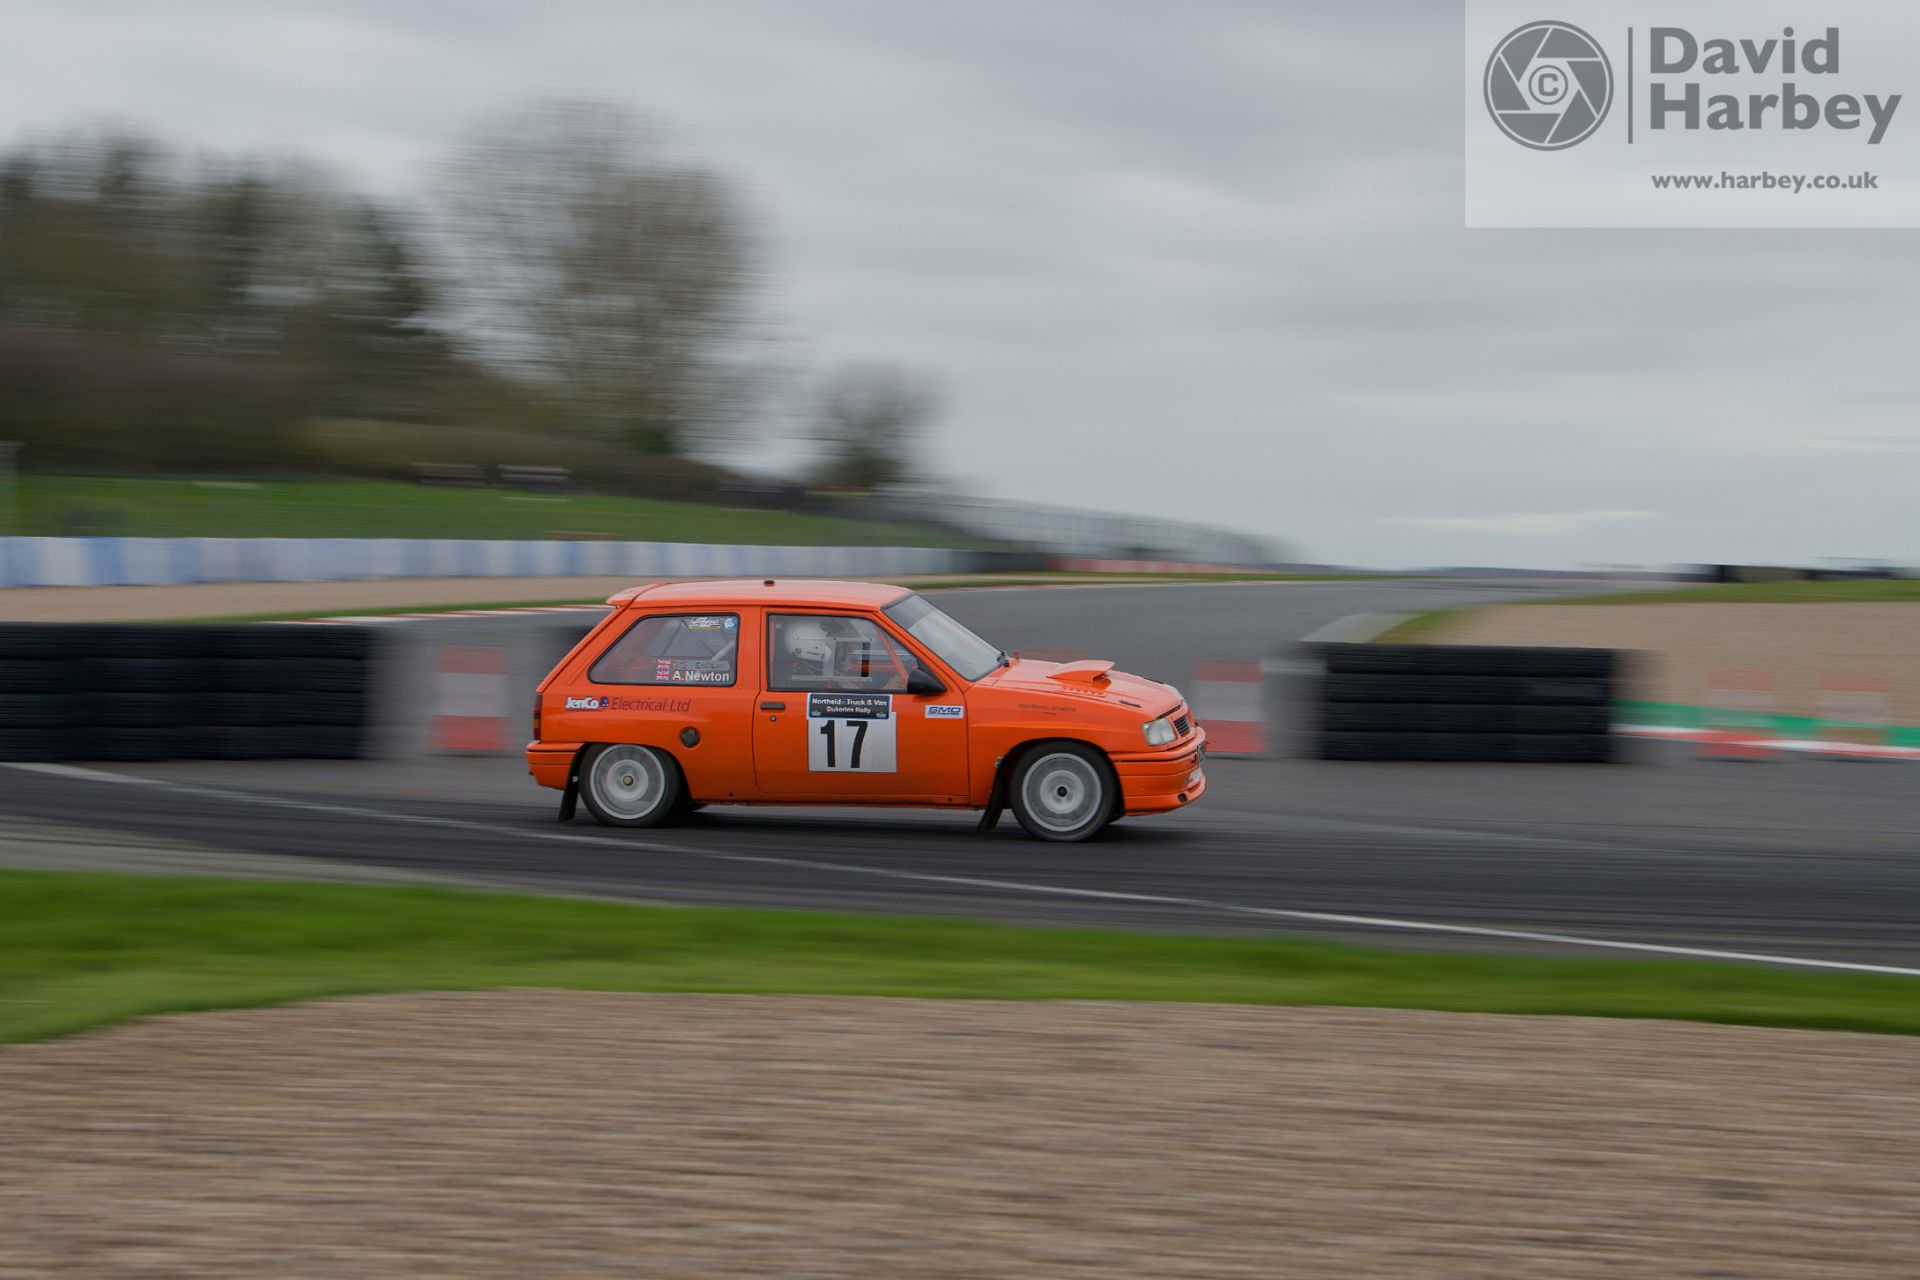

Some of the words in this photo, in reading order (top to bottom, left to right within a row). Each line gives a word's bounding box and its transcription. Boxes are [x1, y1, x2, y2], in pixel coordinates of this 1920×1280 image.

[672, 671, 729, 681] A.Newton
[611, 697, 667, 711] Electrical
[669, 698, 691, 712] Ltd
[820, 719, 868, 768] 17
